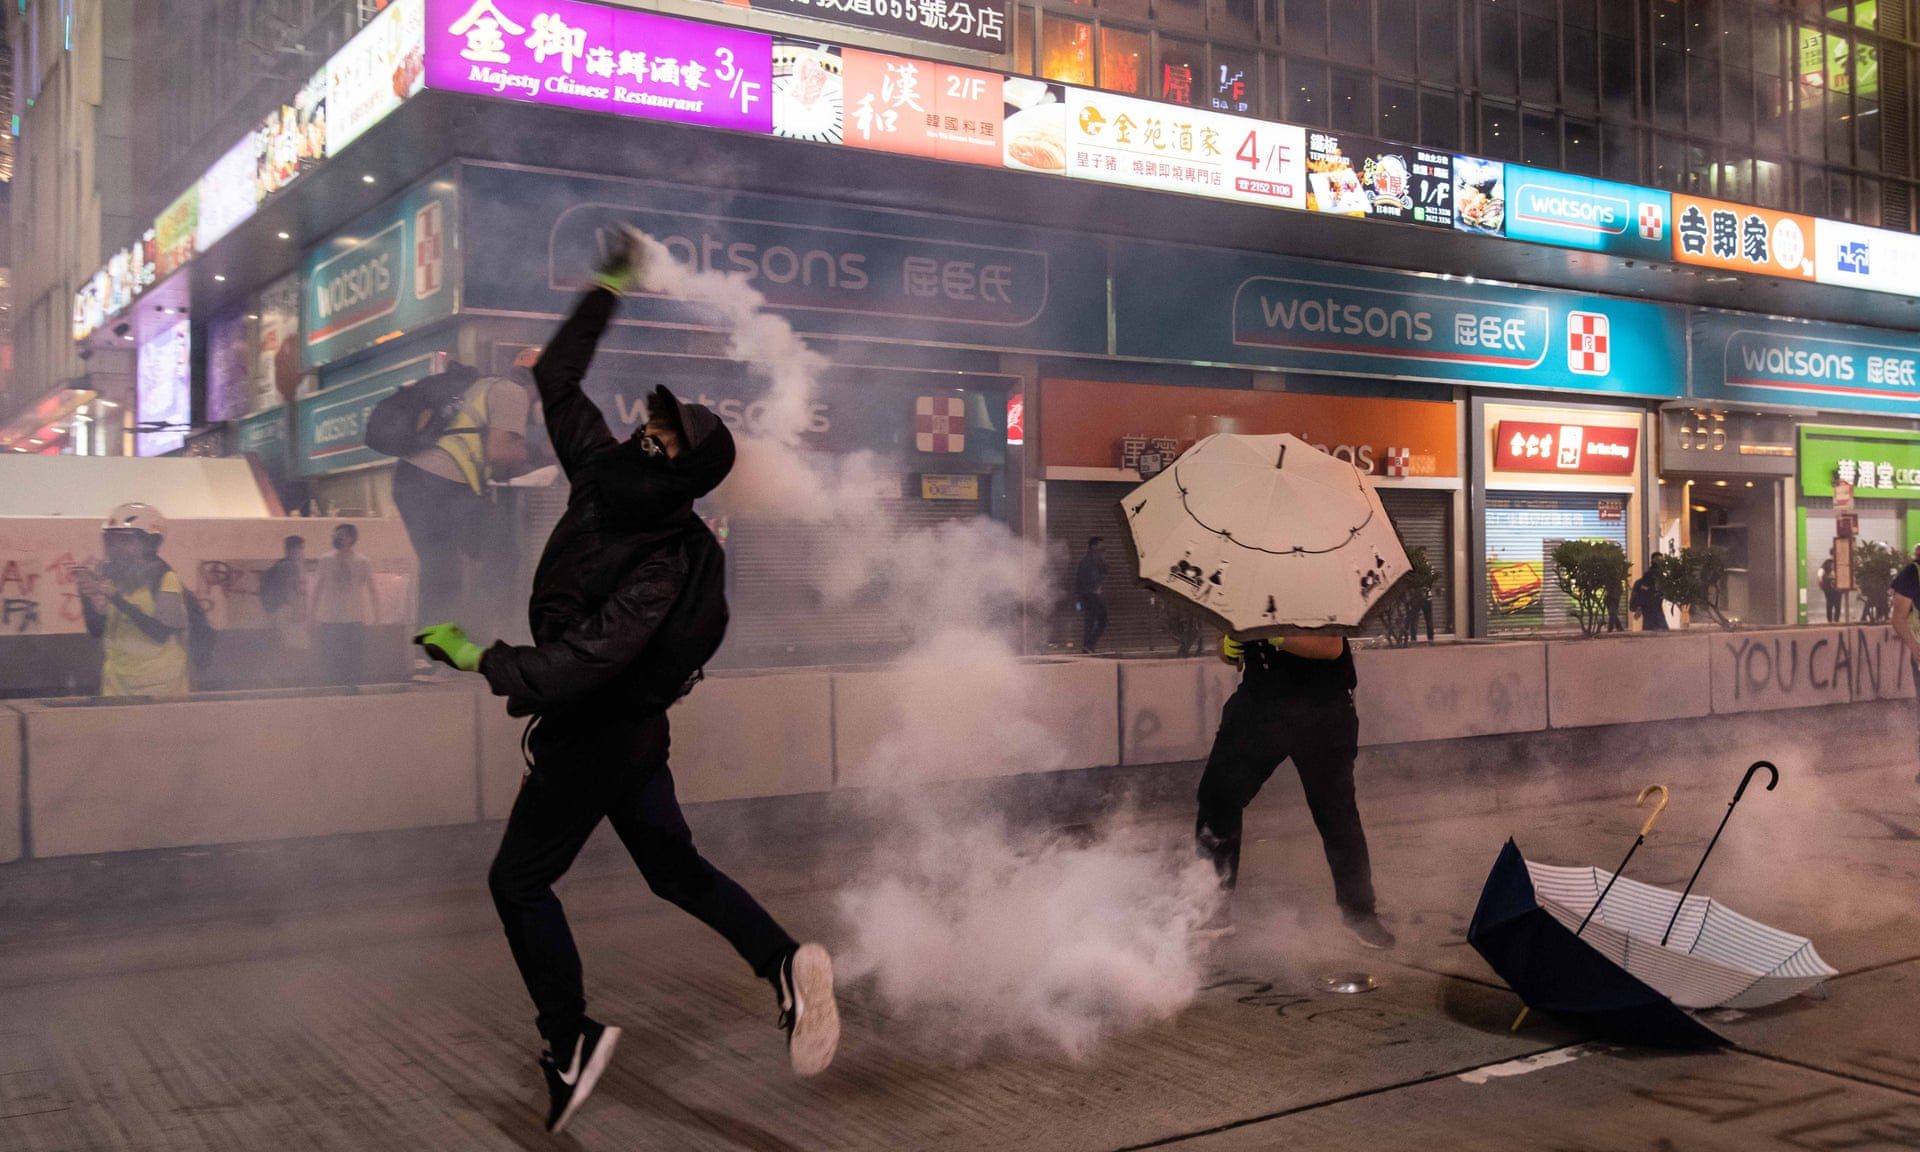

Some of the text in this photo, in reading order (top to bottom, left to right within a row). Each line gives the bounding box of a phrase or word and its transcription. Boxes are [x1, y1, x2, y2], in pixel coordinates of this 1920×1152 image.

[449, 0, 761, 114] 金御 海鮮酒家 3/F
[469, 65, 704, 113] Majesty Chinese Restaurant
[946, 75, 986, 100] 2/F
[1112, 112, 1221, 156] 金苑酒家
[1235, 130, 1290, 174] 4/F
[1420, 180, 1450, 206] 1/F
[1530, 194, 1614, 224] watsons
[903, 256, 1012, 303] 屈臣氏
[1261, 296, 1525, 350] watsons 屈臣氏
[1742, 346, 1918, 387] watsons 屈臣氏
[1726, 638, 1797, 699] YOU
